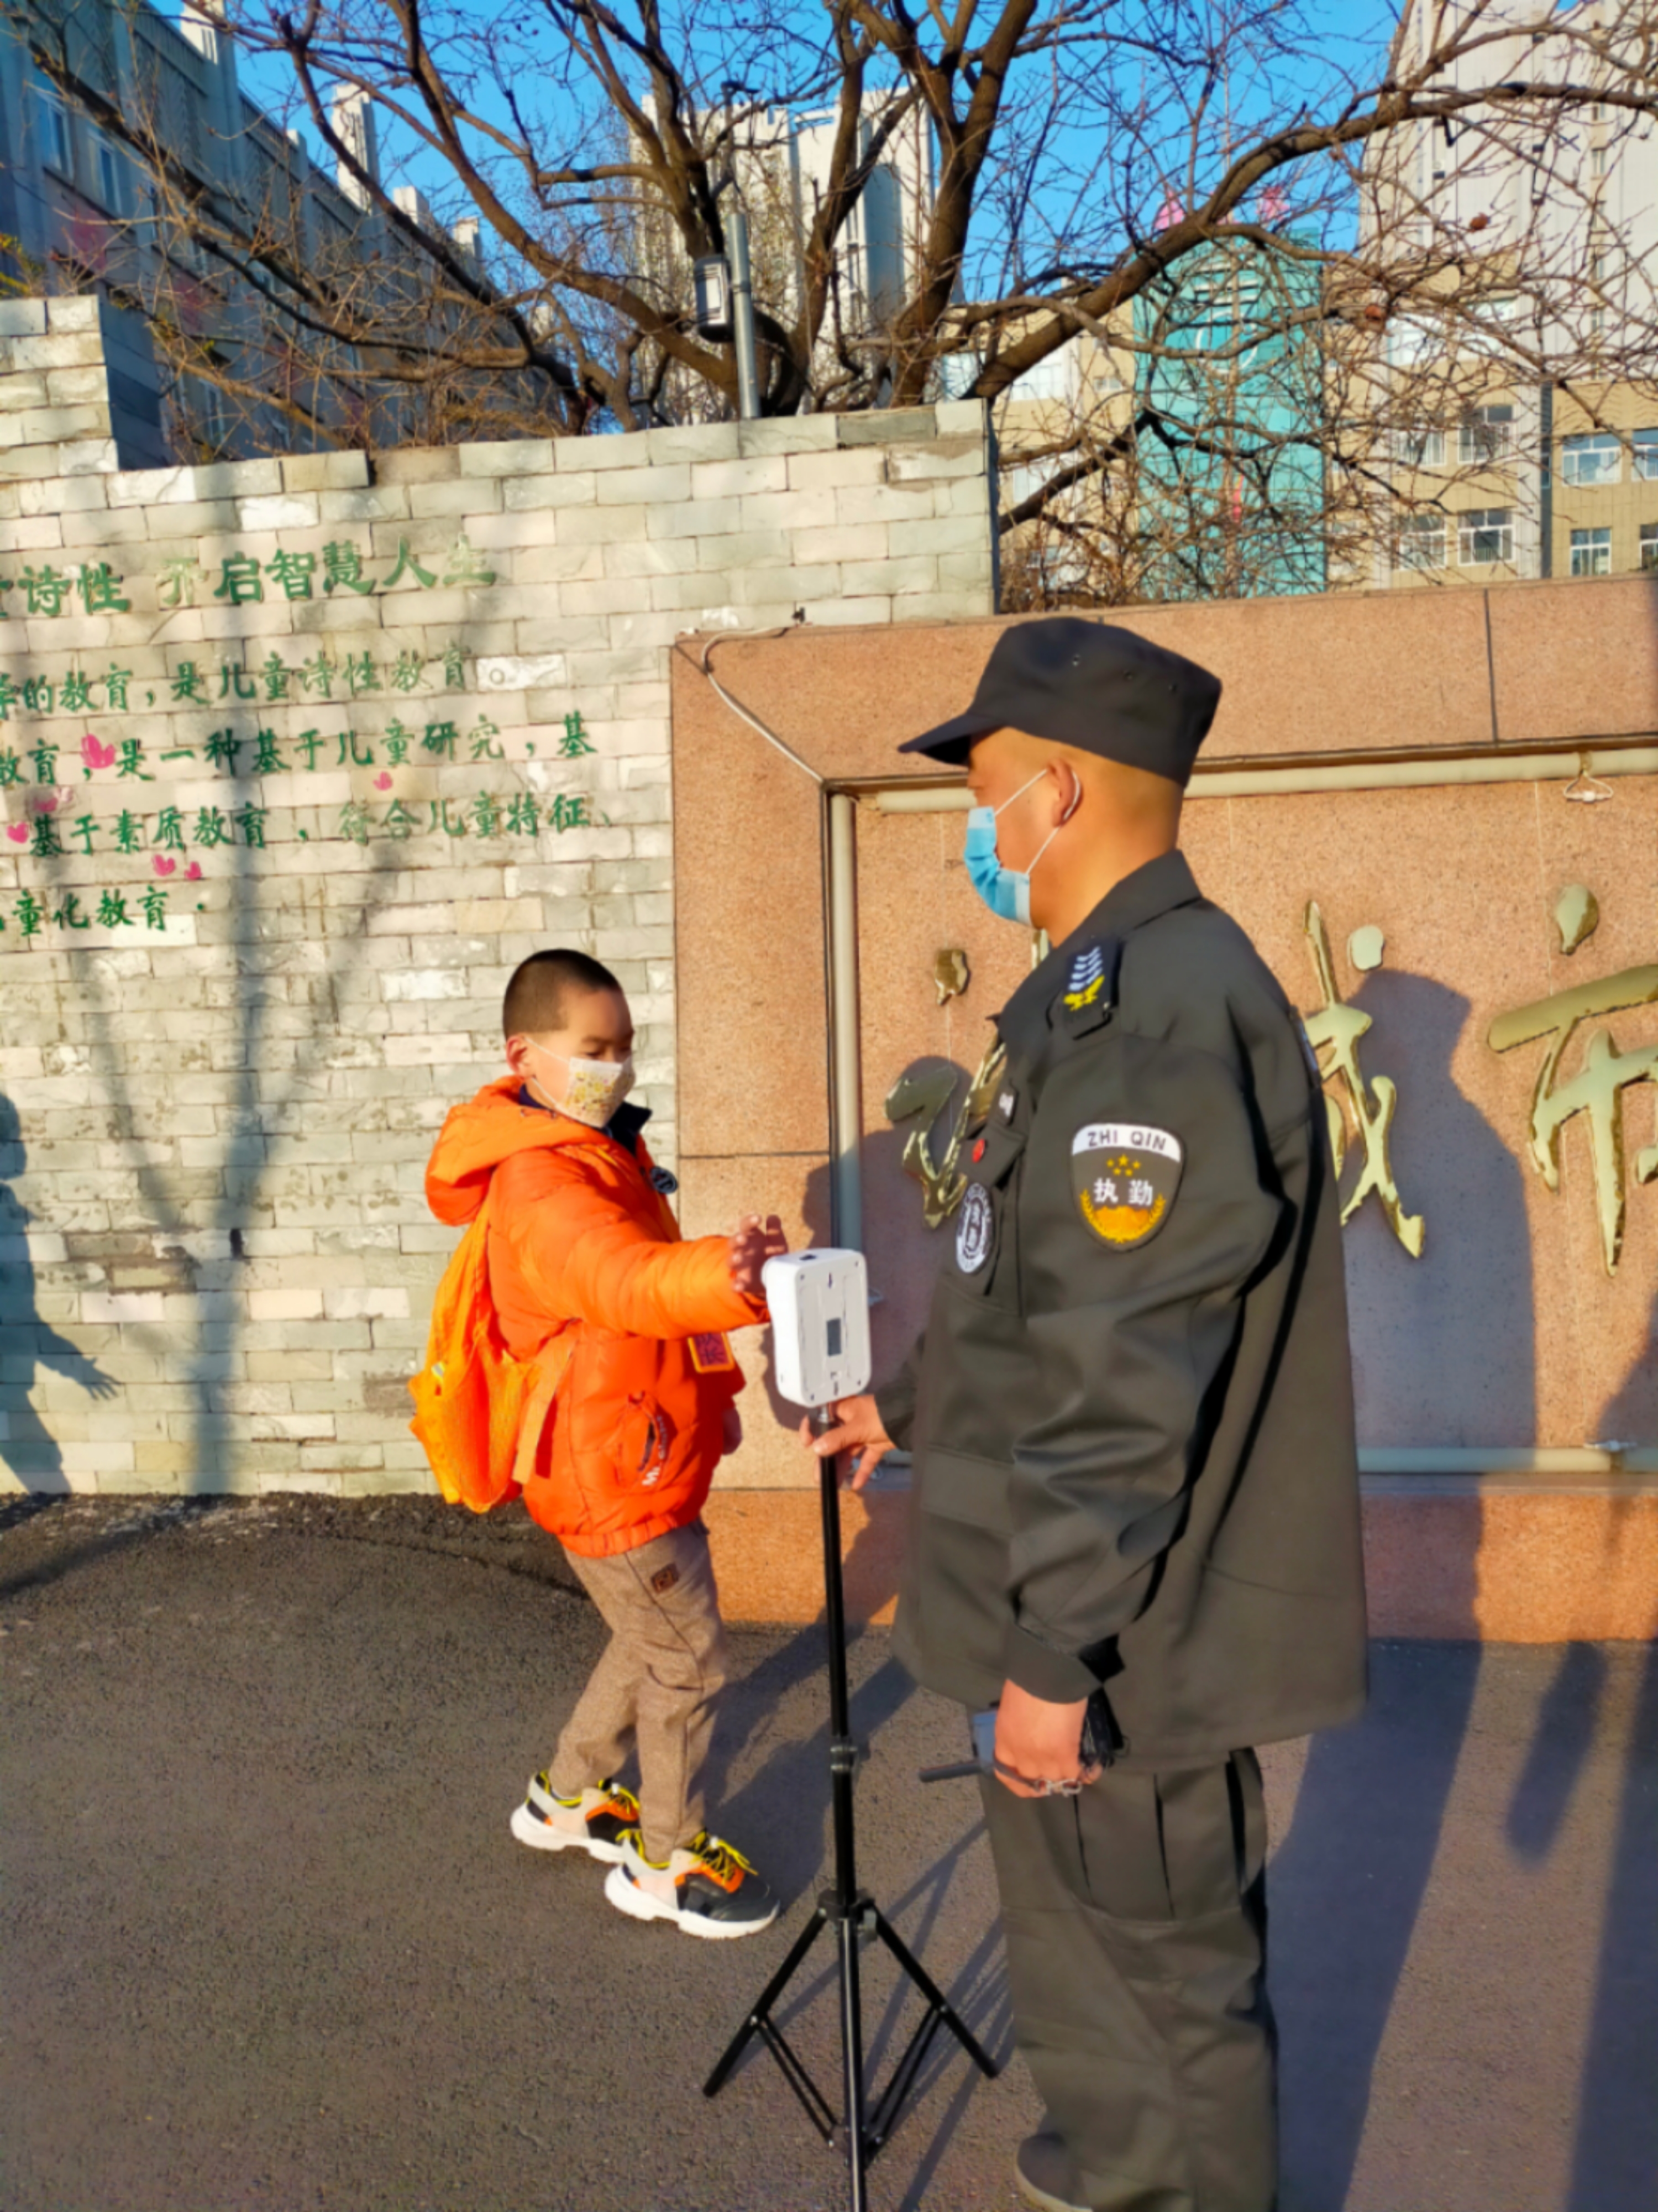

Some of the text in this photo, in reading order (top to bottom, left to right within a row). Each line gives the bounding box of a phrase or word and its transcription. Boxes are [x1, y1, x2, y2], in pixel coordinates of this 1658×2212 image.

[0, 562, 130, 617] 诗性
[1088, 1130, 1166, 1150] ZHI QIN
[1094, 1178, 1153, 1206] 执勤
